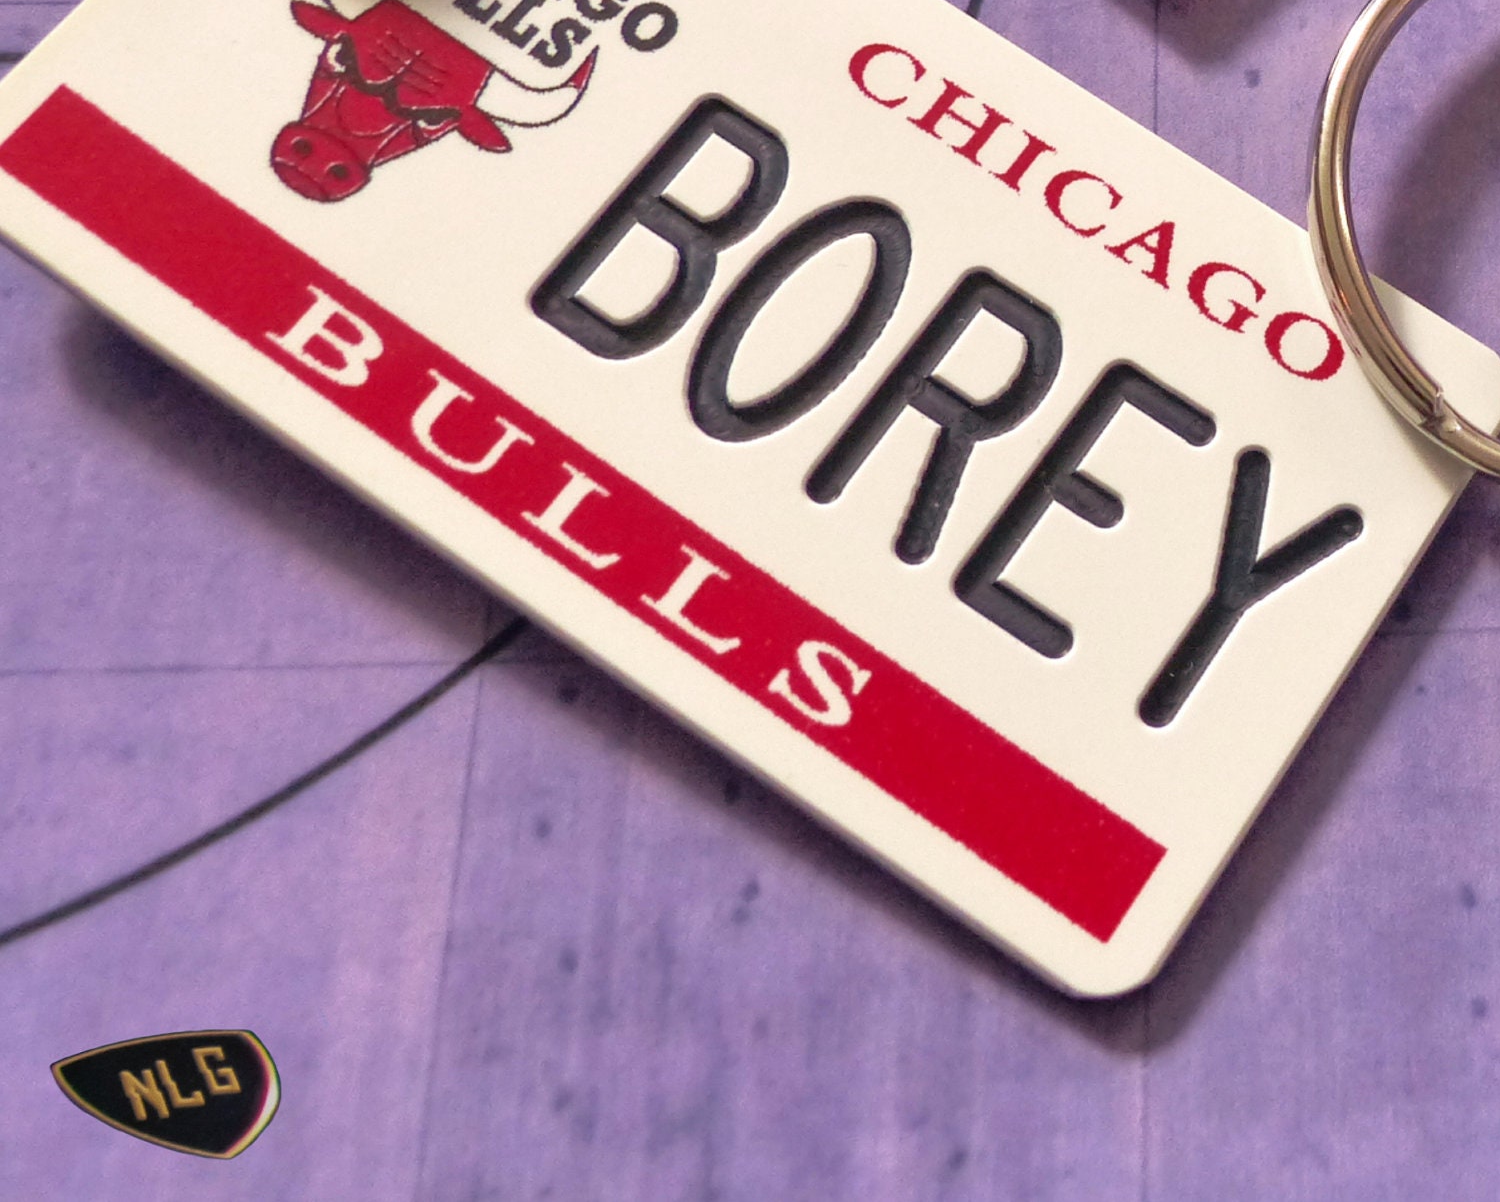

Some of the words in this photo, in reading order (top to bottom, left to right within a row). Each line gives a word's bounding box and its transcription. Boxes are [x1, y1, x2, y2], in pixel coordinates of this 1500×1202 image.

[529, 91, 1365, 730] BOREY
[848, 42, 1346, 381] CHICAGO
[266, 285, 872, 730] BULLS
